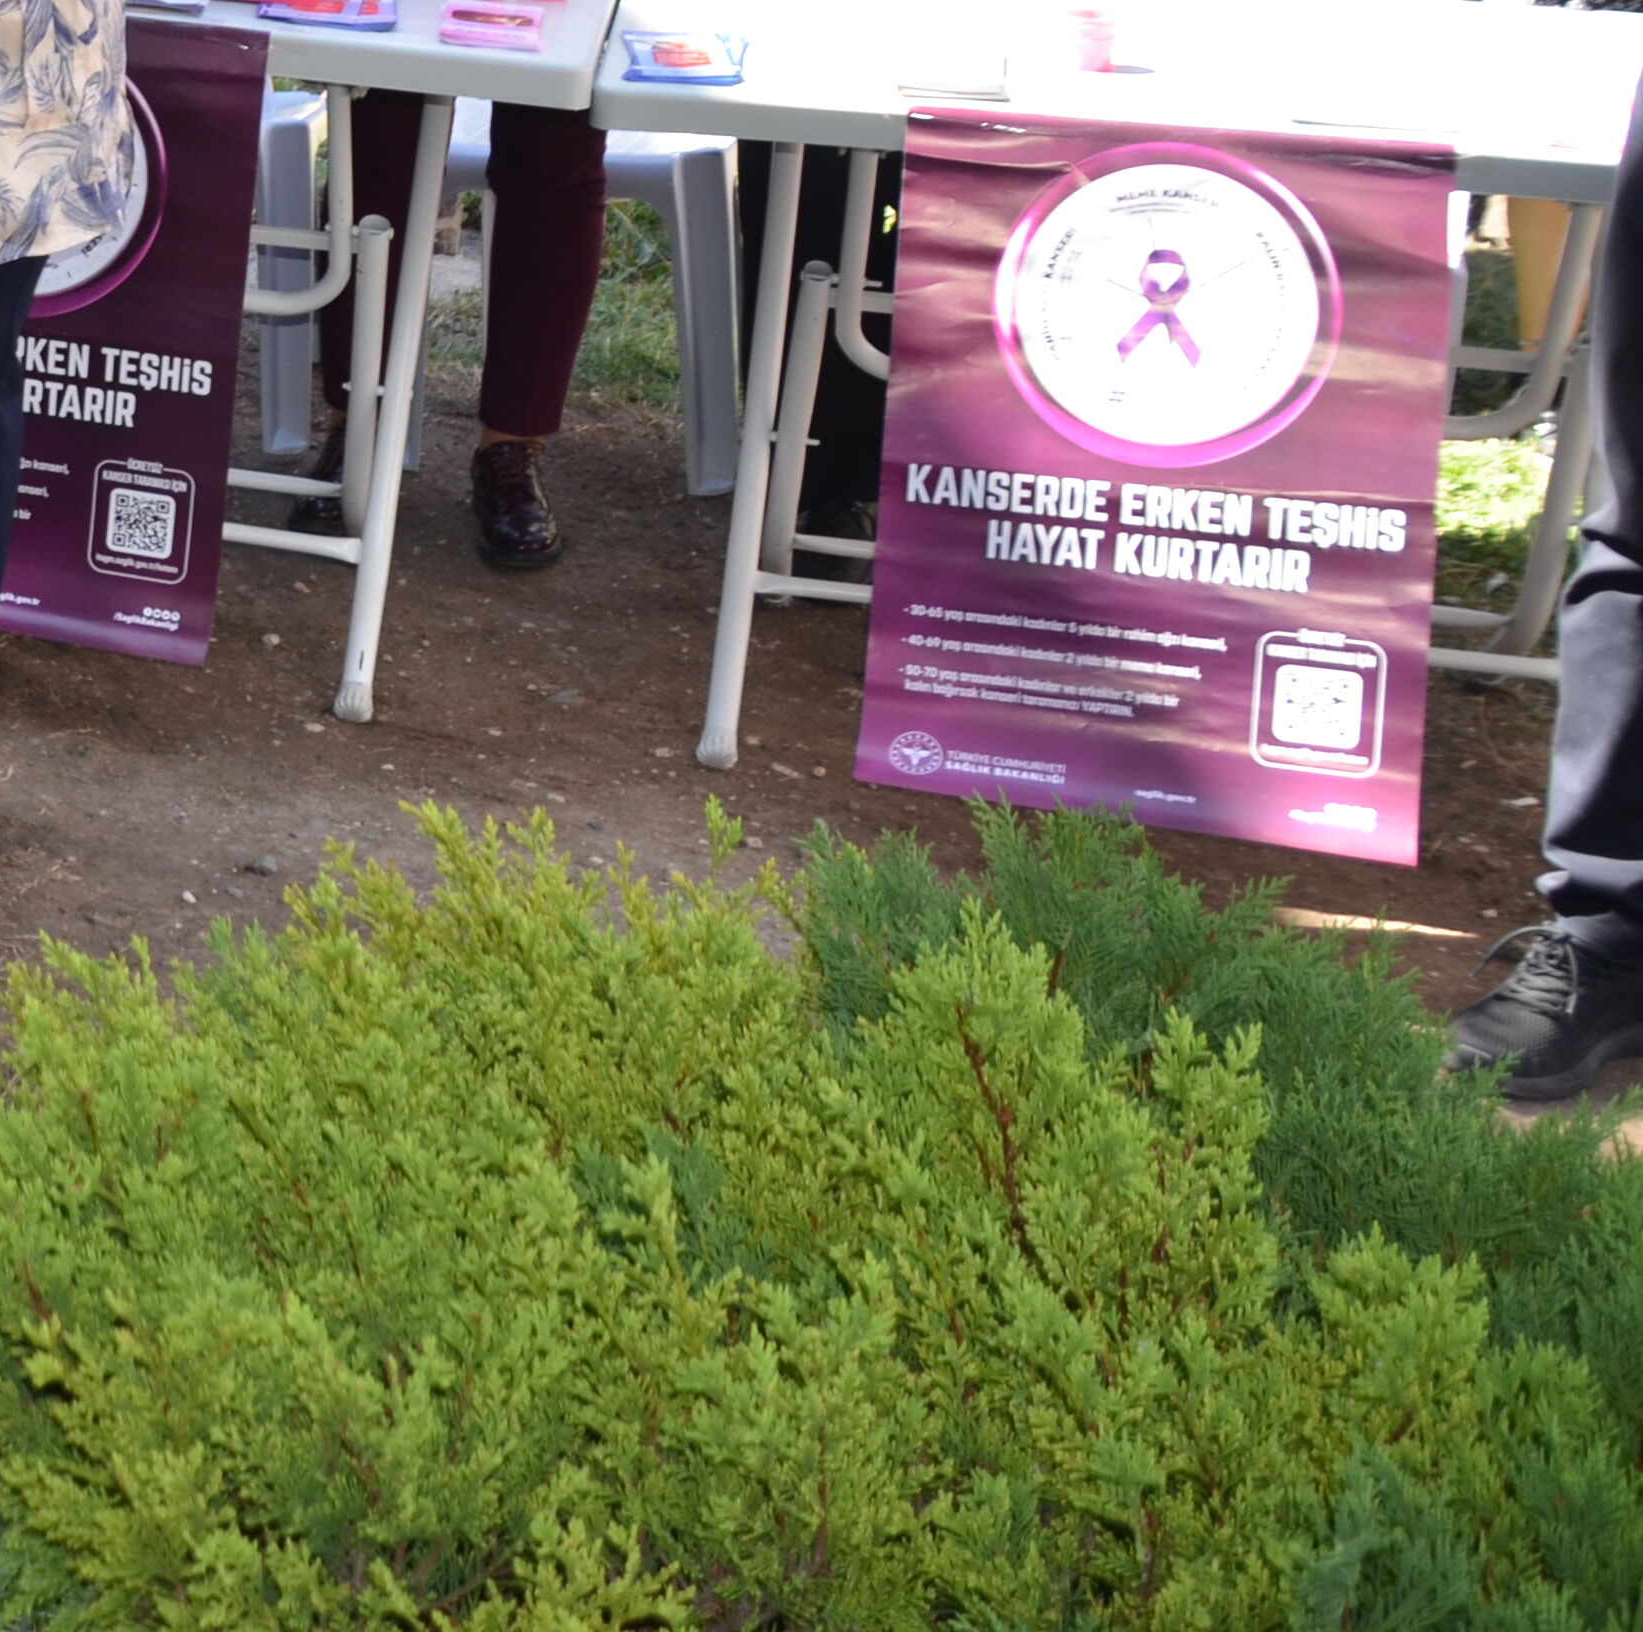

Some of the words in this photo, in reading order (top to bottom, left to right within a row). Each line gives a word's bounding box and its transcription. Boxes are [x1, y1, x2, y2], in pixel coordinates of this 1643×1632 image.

[22, 378, 137, 428] RTARIR
[905, 463, 1111, 522] KANSERDE
[1119, 482, 1253, 537] ERKEN
[986, 519, 1106, 570] HAYAT
[1113, 532, 1311, 593] KURTARIR
